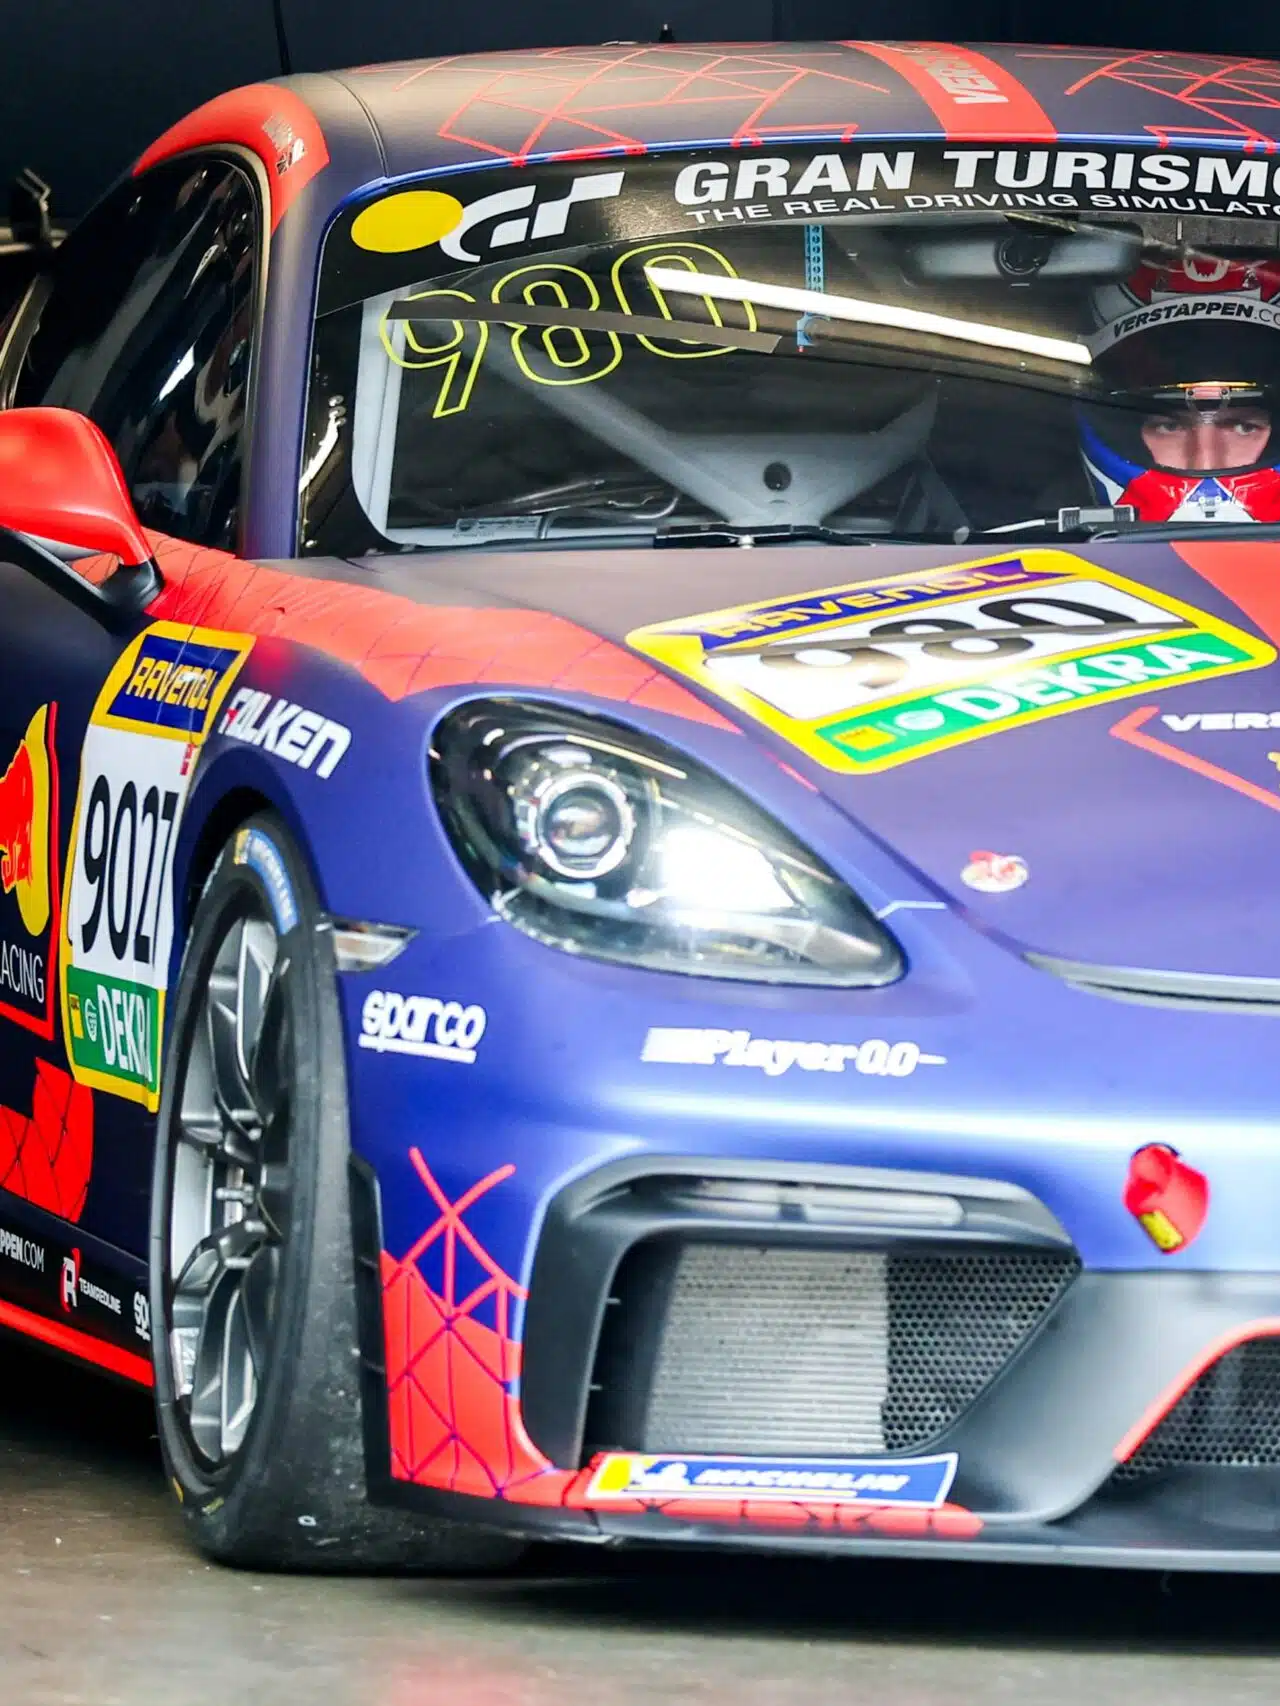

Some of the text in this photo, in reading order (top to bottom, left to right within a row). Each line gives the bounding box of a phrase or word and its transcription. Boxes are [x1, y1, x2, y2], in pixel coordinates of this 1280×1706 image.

[674, 151, 915, 206] GRAN
[685, 204, 773, 224] THE
[783, 197, 896, 215] REAL
[904, 192, 1079, 208] DRIVING
[379, 242, 758, 419] 980
[704, 571, 1029, 639] RAVENOL
[125, 656, 218, 711] RAVENOL
[931, 643, 1234, 721] DEKRA
[217, 686, 353, 780] FALKEN
[81, 774, 180, 969] 9027
[0, 939, 45, 1004] ACING
[361, 990, 487, 1053] sparco
[691, 1467, 911, 1492] MICHELIN
